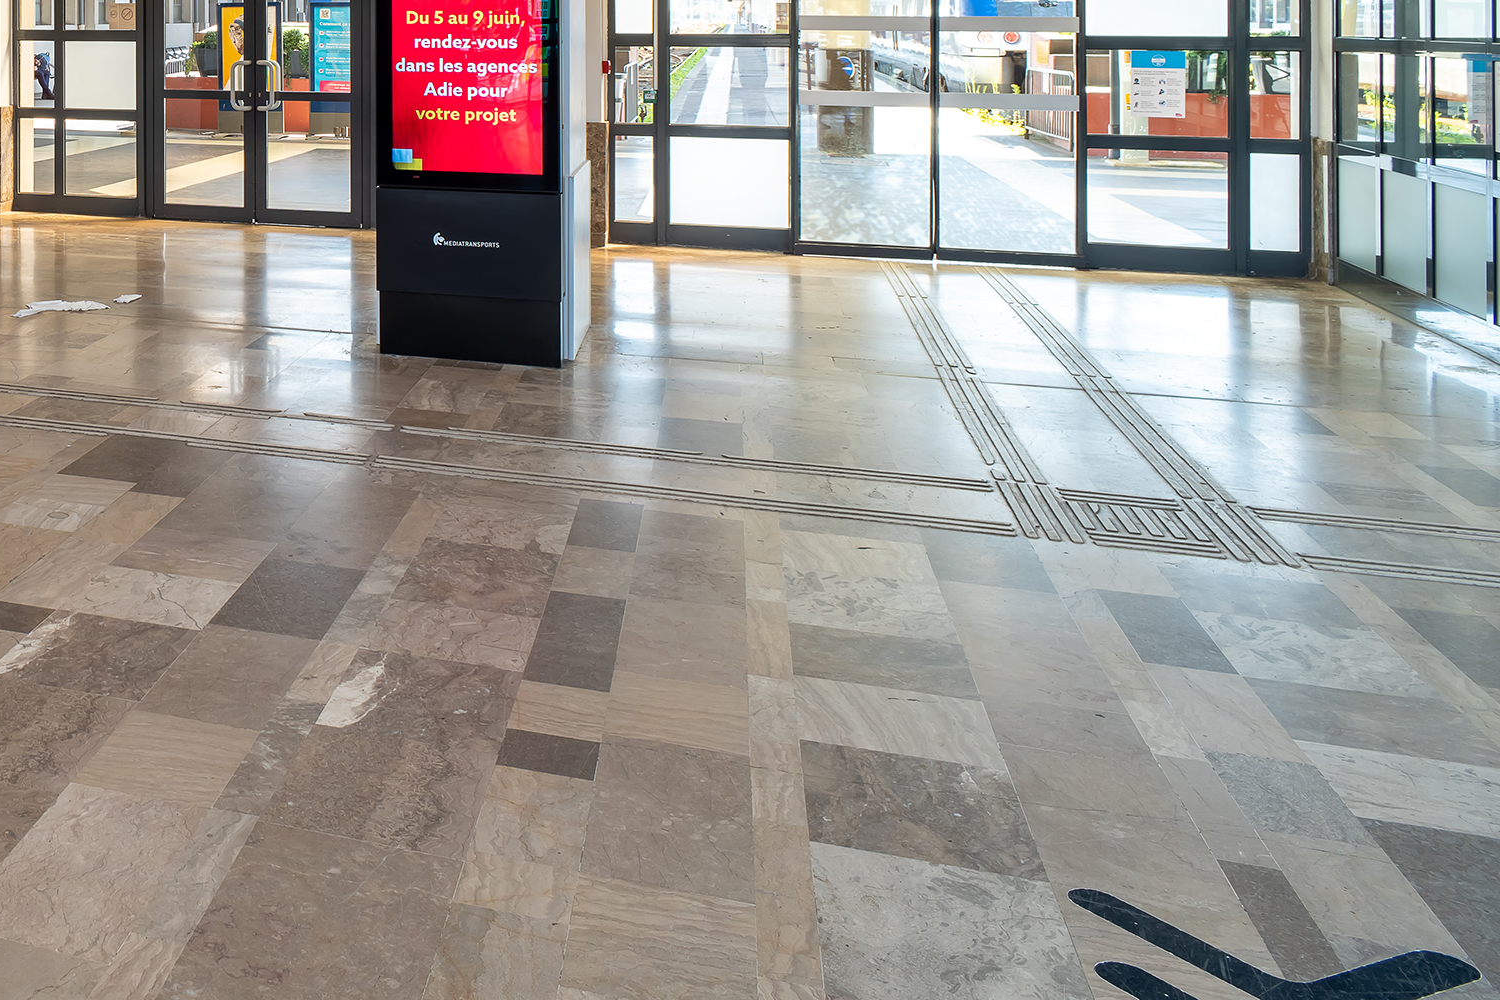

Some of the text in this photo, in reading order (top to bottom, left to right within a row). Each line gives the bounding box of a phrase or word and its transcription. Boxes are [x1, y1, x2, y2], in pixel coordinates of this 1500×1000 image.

[414, 34, 518, 49] rendez-vous
[395, 57, 538, 77] dans agences
[423, 82, 463, 97] Adie
[416, 107, 517, 125] votre projet
[443, 240, 500, 248] MEDIATRANSPORTS
